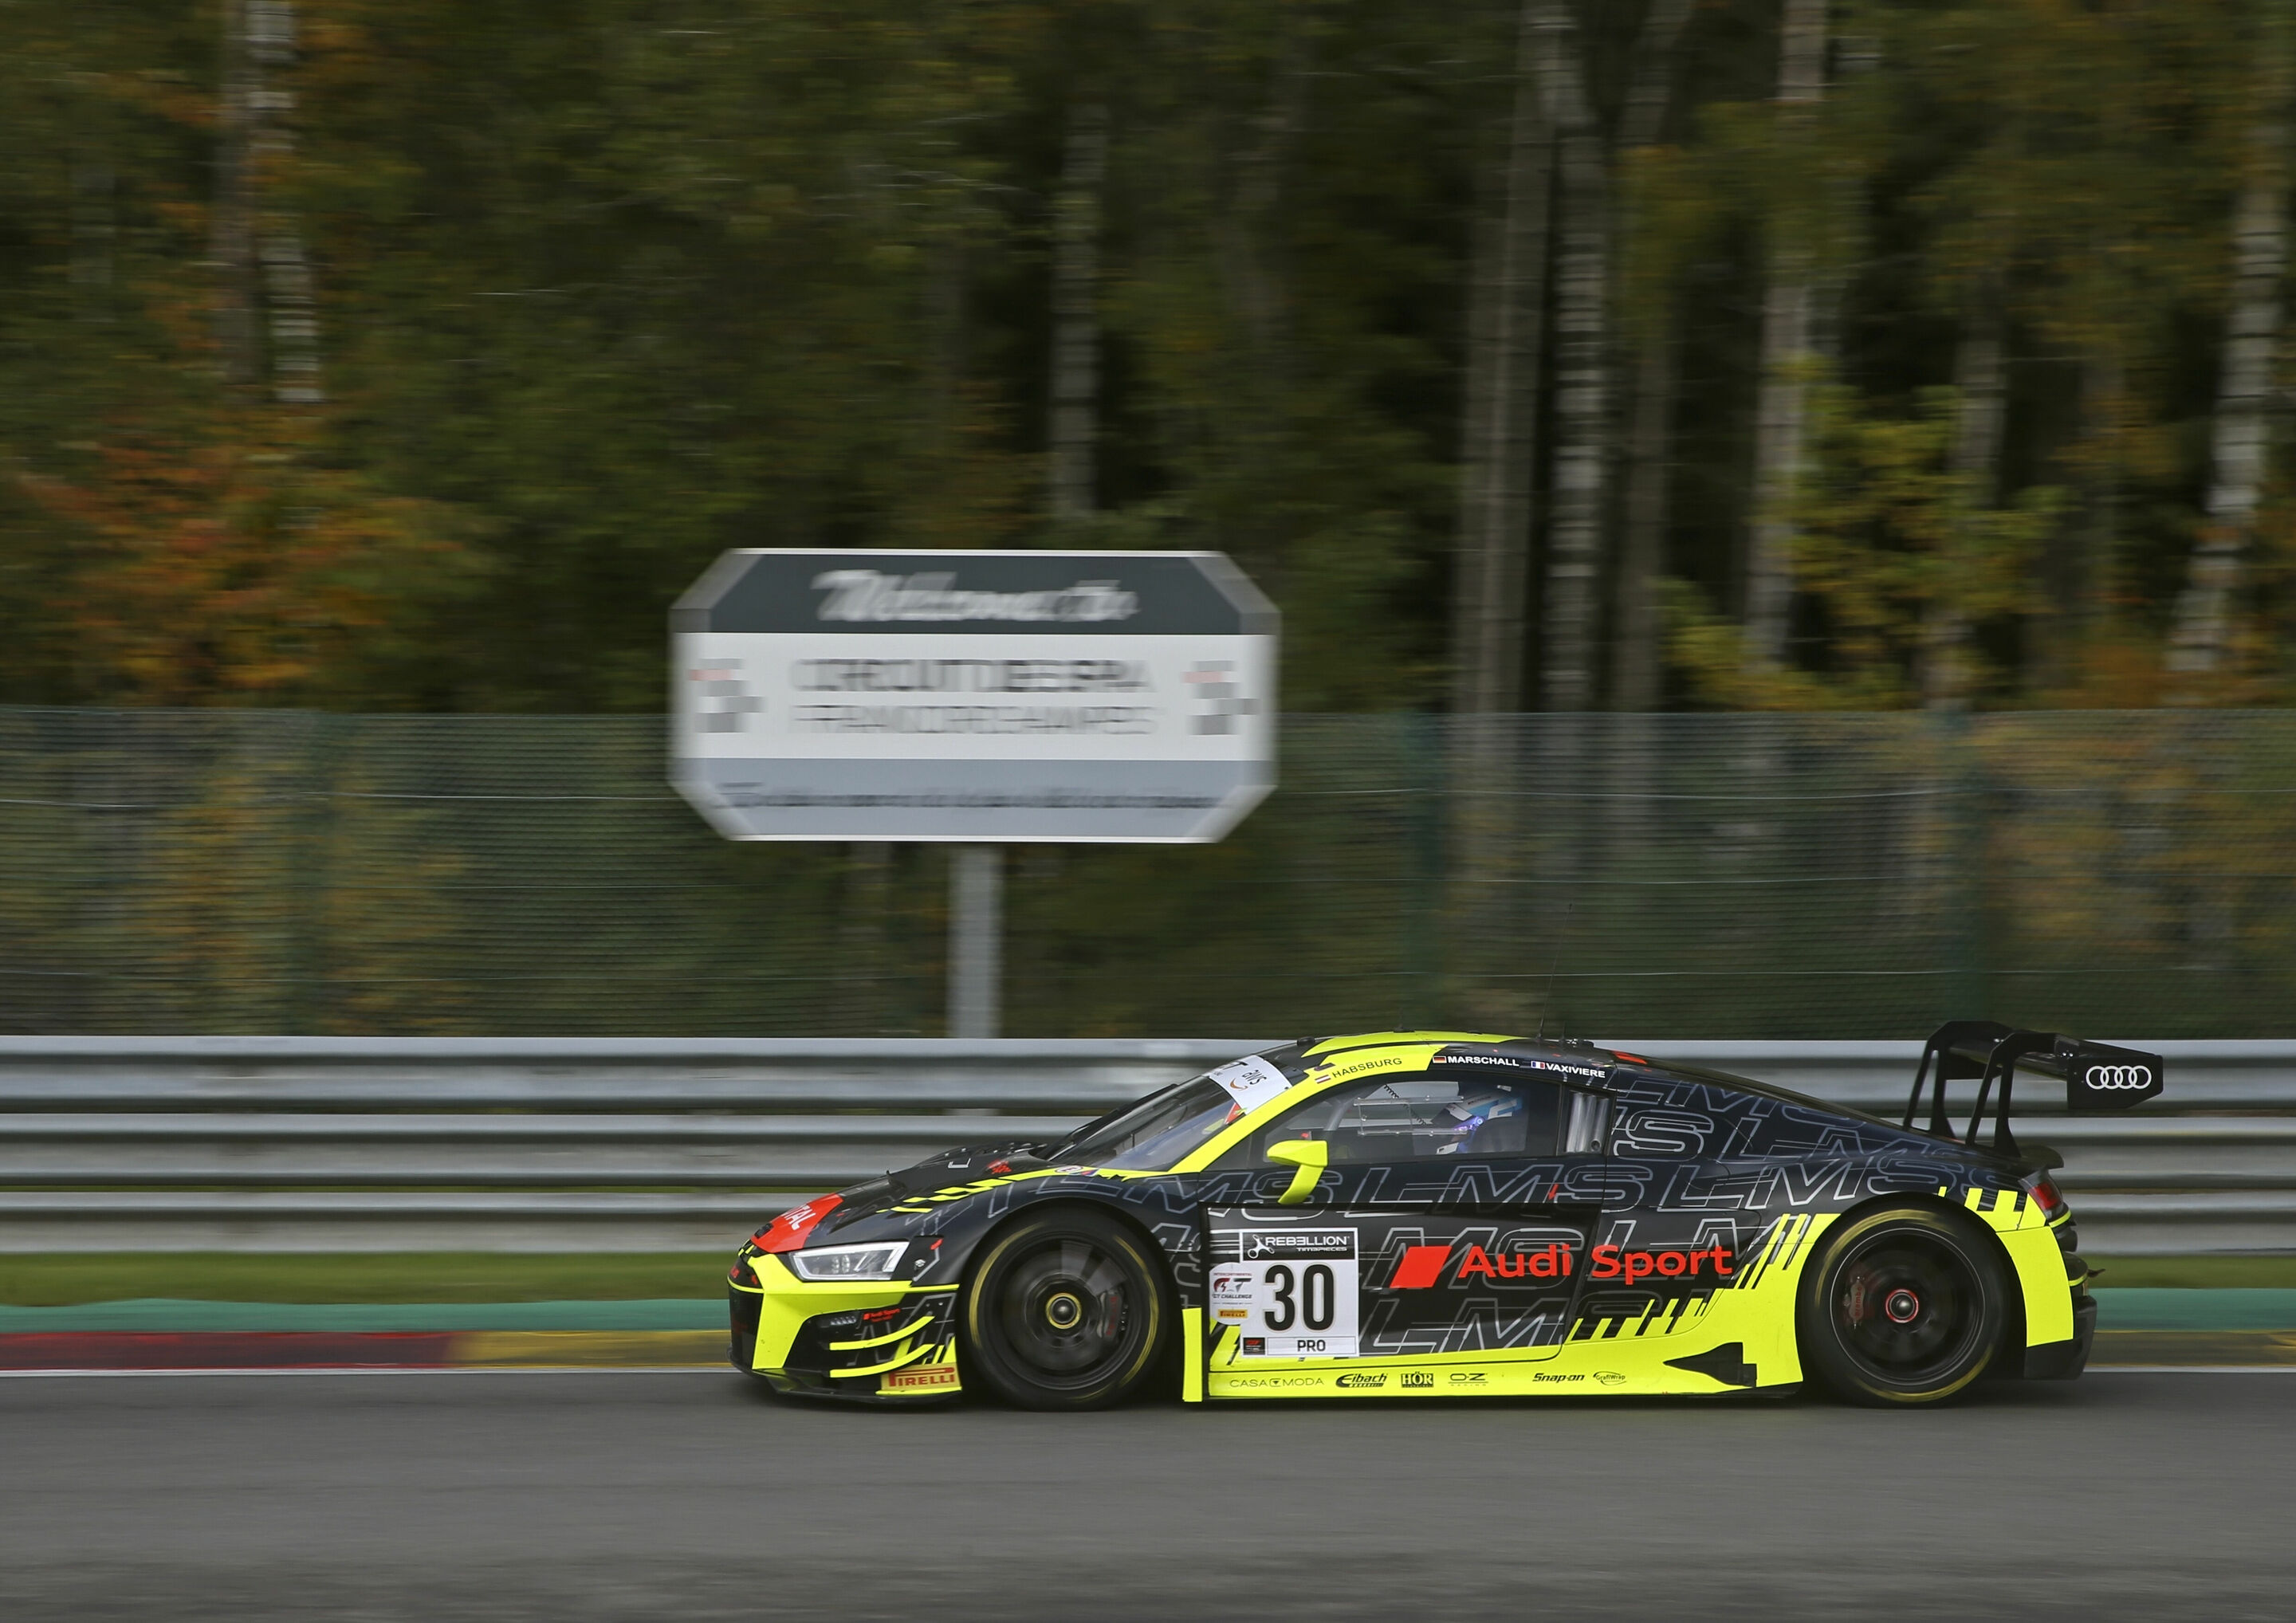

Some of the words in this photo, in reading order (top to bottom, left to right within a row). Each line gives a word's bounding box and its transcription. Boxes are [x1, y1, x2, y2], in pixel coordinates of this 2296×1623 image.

[1332, 1058, 1402, 1078] HABSBURG
[1448, 1056, 1520, 1067] MARSCHALL
[1546, 1063, 1606, 1078] VAXIVIERE
[1457, 1244, 1571, 1279] Audi
[1591, 1244, 1733, 1285] Sport
[1264, 1264, 1335, 1330] 30
[1297, 1340, 1327, 1352] PRO
[889, 1367, 955, 1387] PIRELLI
[1229, 1378, 1268, 1388] CASA
[1282, 1377, 1325, 1387] MODA
[1335, 1373, 1388, 1387] Eibach
[1402, 1371, 1433, 1385] HÖR
[1532, 1373, 1586, 1383] Snap-on
